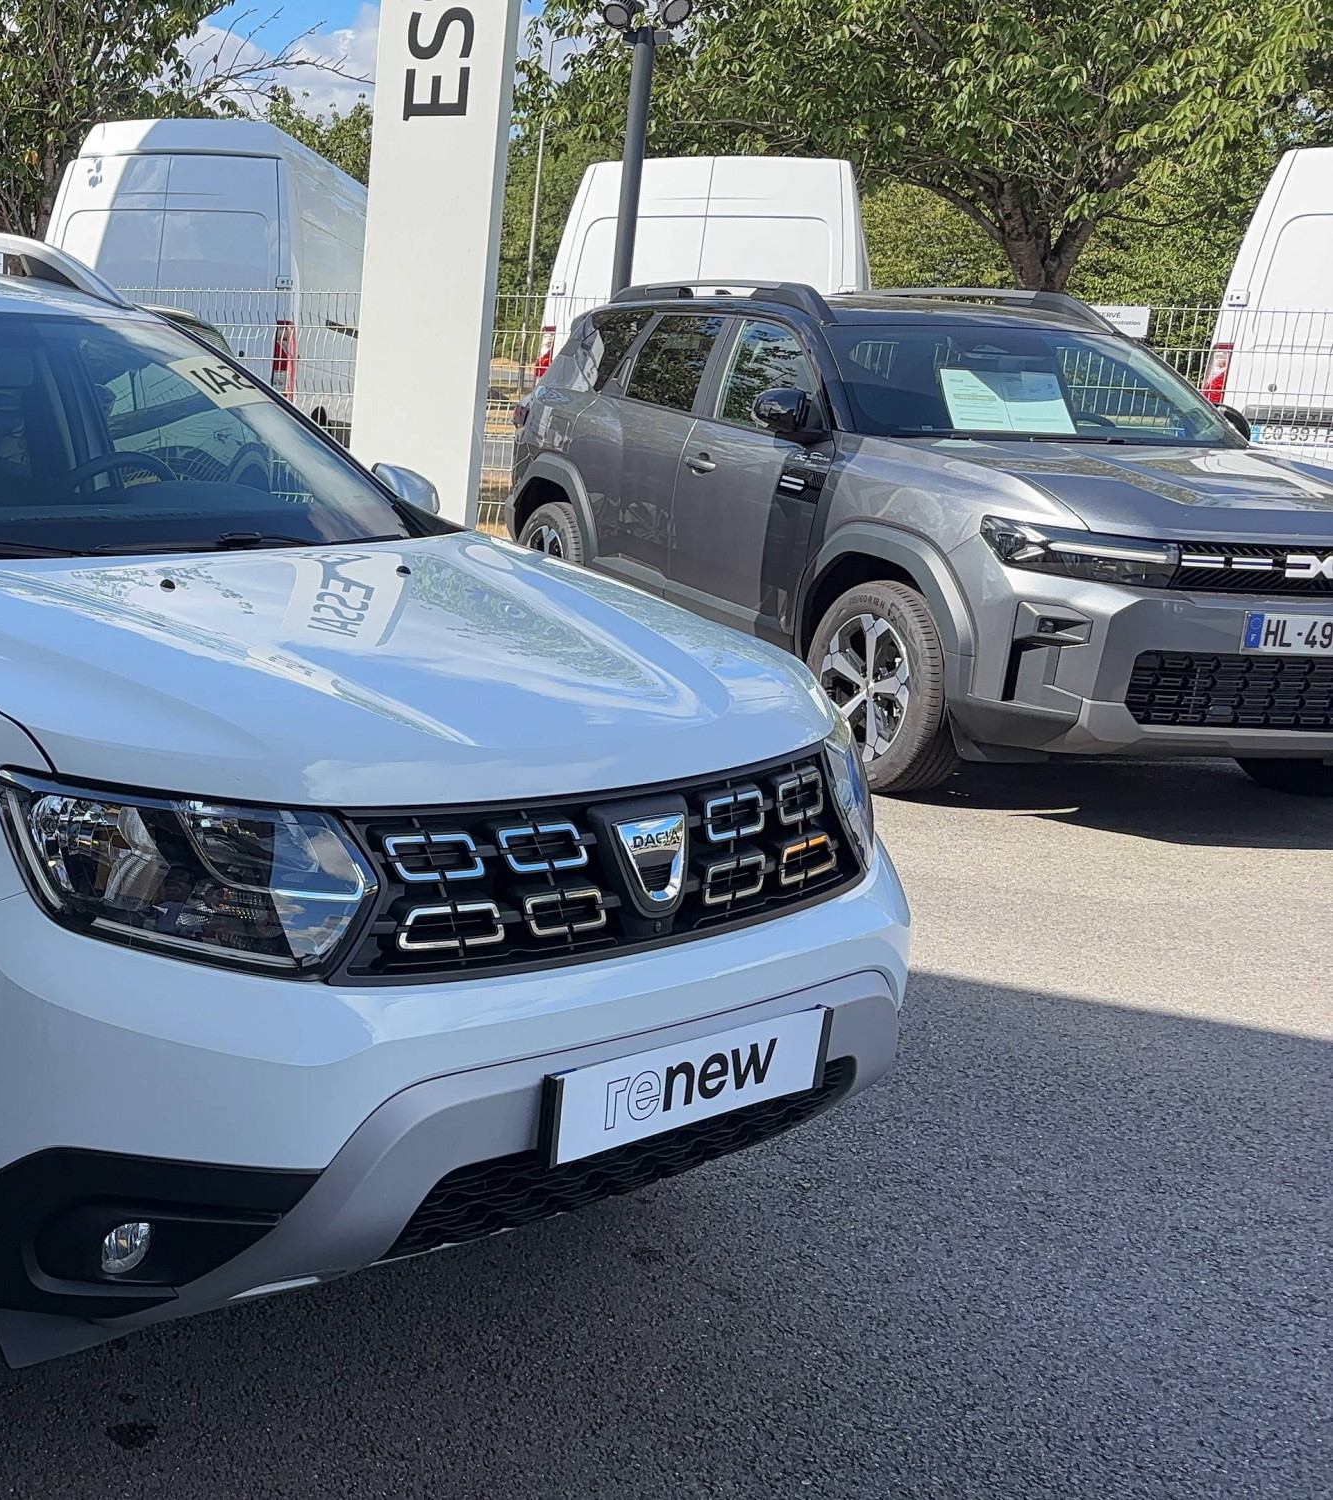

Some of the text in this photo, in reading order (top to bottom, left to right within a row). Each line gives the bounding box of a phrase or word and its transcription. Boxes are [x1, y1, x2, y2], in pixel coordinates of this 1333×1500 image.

[403, 0, 474, 121] ES
[632, 828, 680, 848] DACIA
[604, 1037, 778, 1131] renew
